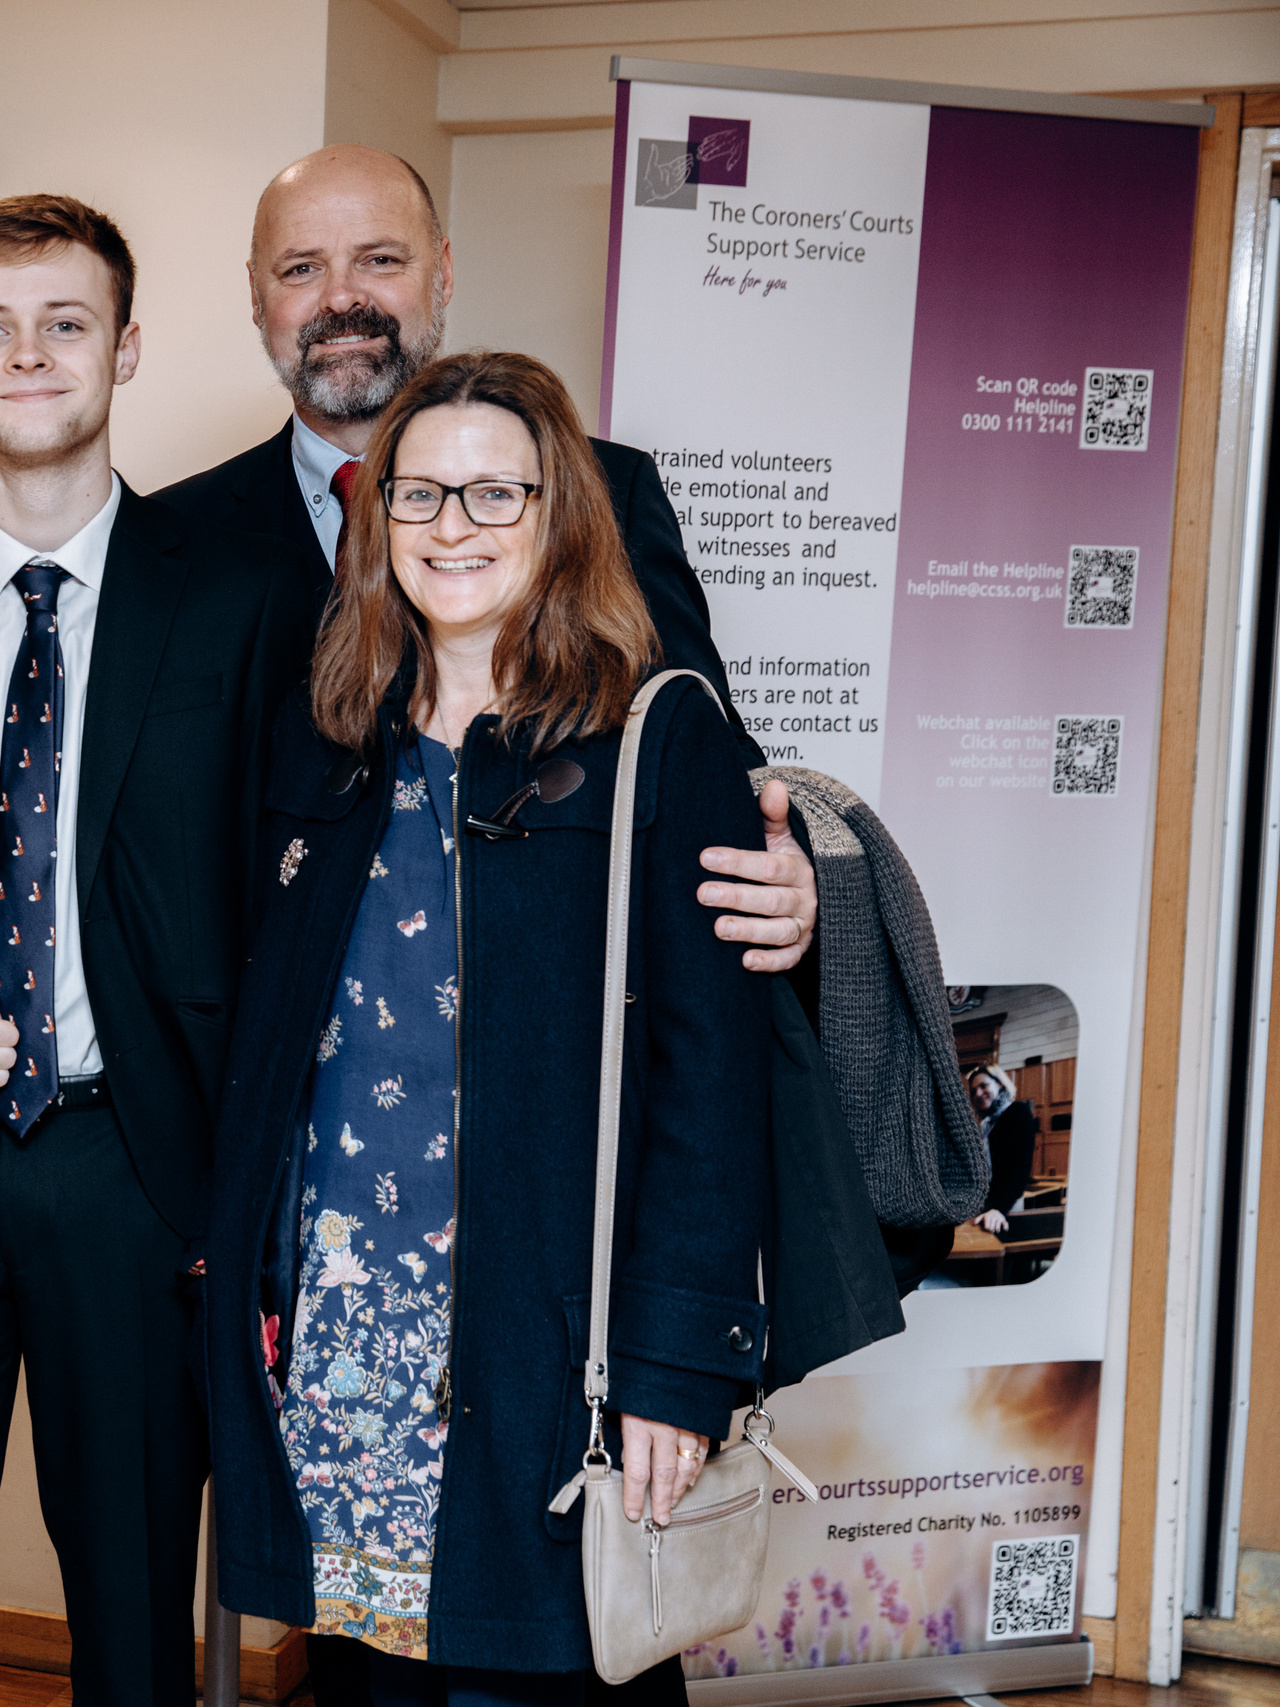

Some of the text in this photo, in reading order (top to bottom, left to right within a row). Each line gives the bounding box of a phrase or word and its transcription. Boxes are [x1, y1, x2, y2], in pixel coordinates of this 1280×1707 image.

[709, 201, 913, 235] The Coroners' Courts
[707, 233, 866, 263] Support Service
[703, 265, 787, 297] Here for you
[976, 375, 1078, 397] Scan QR code
[1014, 397, 1076, 416] Helpline
[961, 413, 1074, 434] 0300 111 2141
[653, 448, 832, 473] trained volunteers
[689, 480, 787, 500] emotional
[794, 482, 829, 501] and
[701, 510, 774, 532] support
[783, 511, 802, 529] to
[809, 510, 897, 532] bereaved
[698, 537, 836, 559] witnesses and
[772, 568, 795, 586] an
[802, 567, 877, 592] inquest.
[928, 560, 1065, 582] Email the Helpline
[907, 579, 1063, 602] helpline@ccss.org.uk
[759, 655, 870, 677] information
[764, 689, 796, 704] are
[802, 687, 833, 705] not
[840, 687, 859, 705] at
[780, 714, 852, 732] contact
[859, 717, 879, 732] us
[916, 714, 1051, 731] Webchat available
[960, 733, 1050, 750] Click on the
[949, 752, 1048, 769] webchat icon
[936, 773, 1047, 788] on our website
[772, 1464, 1085, 1505] ersourtssupportservice.org
[827, 1505, 1081, 1542] Registered Charity No. 1105899
